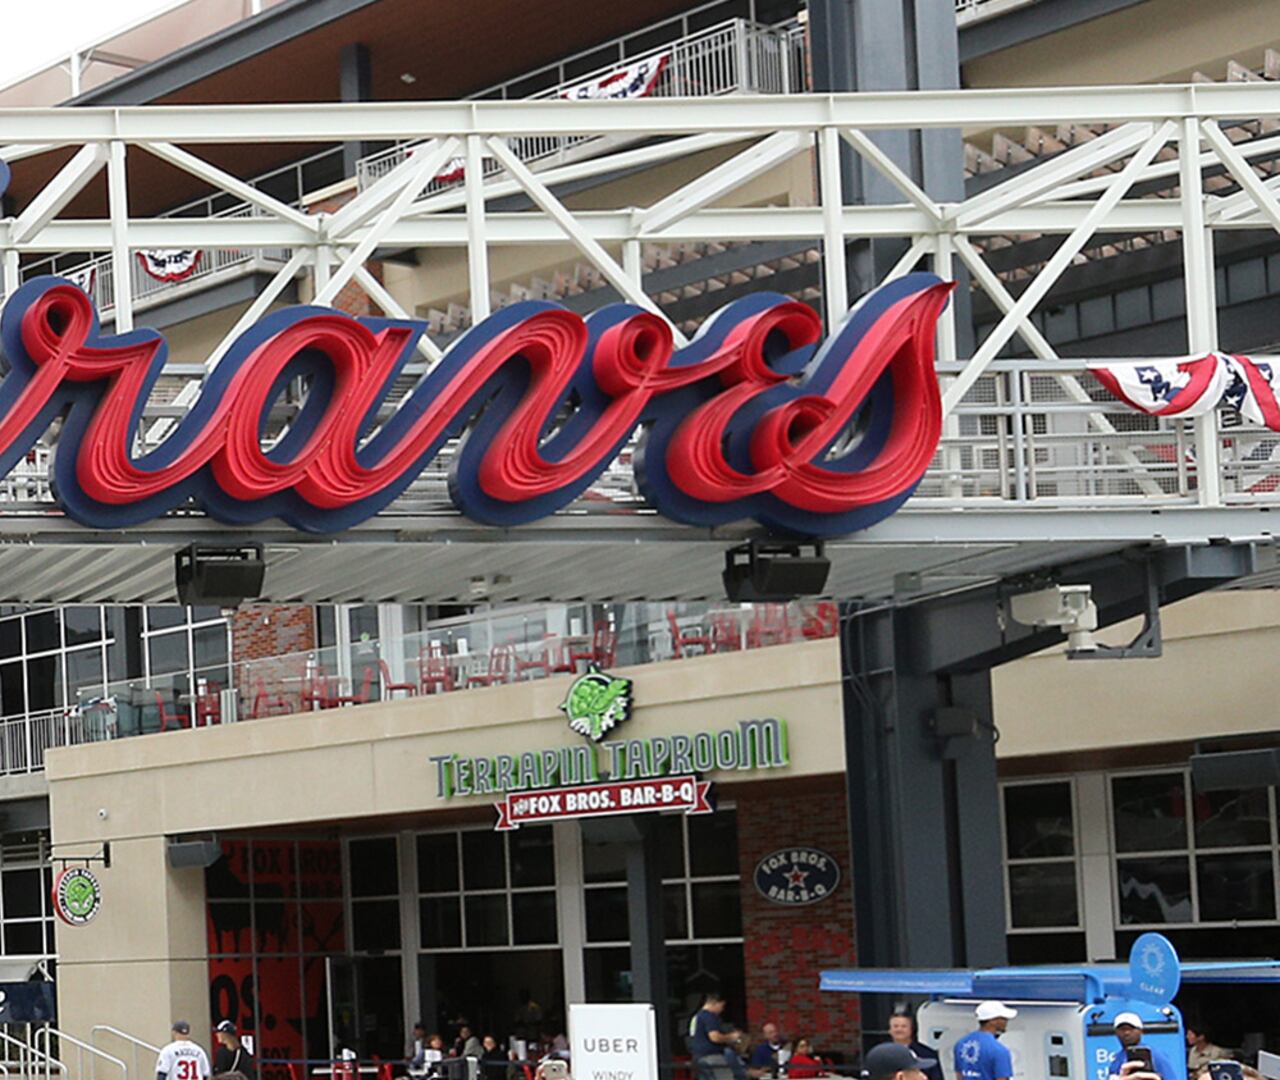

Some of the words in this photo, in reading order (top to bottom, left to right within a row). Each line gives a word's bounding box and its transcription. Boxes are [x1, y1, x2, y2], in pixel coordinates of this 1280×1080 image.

[430, 746, 598, 800] TERRAPIN
[605, 717, 790, 783] TAPROOM
[529, 793, 562, 816] FOX
[566, 788, 616, 811] BROS.
[620, 782, 693, 808] BAR-B-Q
[761, 853, 788, 875] FOX
[583, 1038, 639, 1053] UBER
[177, 1060, 199, 1080] 31
